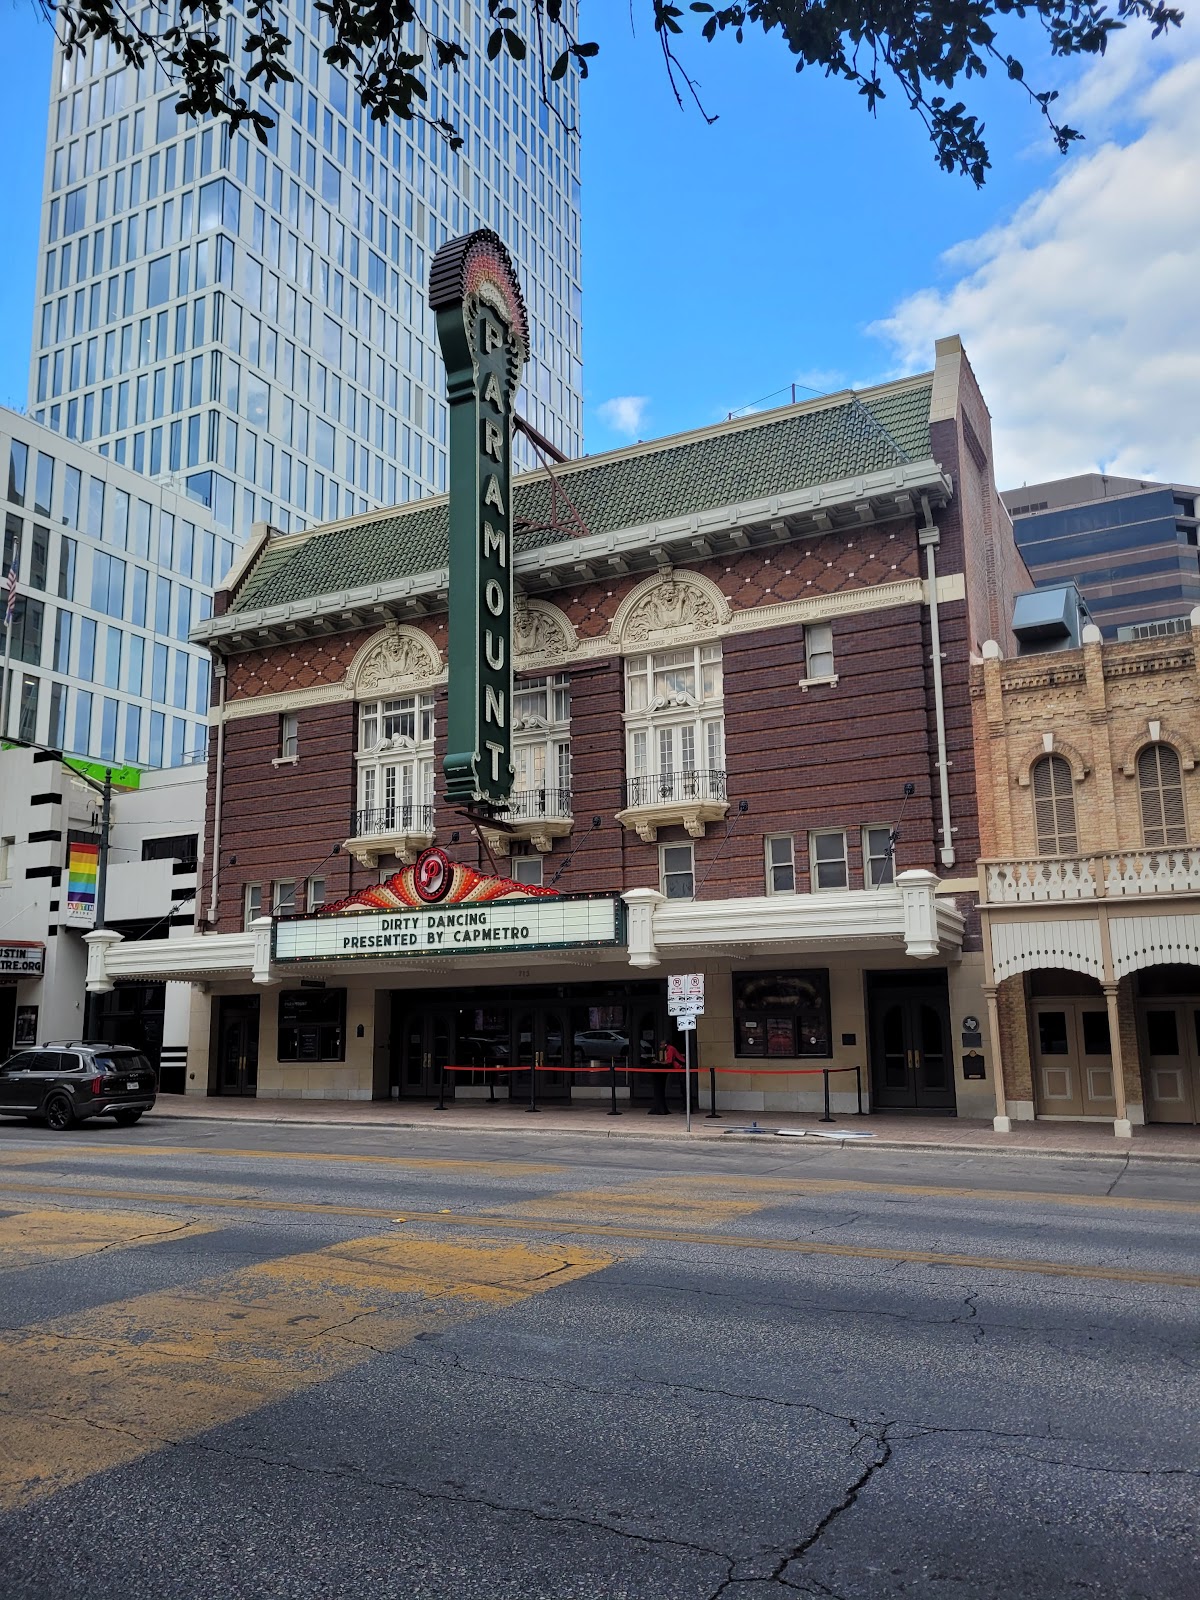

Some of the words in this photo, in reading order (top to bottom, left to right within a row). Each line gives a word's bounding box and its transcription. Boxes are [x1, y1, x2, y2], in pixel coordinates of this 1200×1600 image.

[481, 318, 505, 781] PARAMOUNT
[662, 628, 678, 636] 1915
[382, 917, 419, 931] DIRTY
[427, 912, 487, 928] DANCING
[343, 933, 417, 949] PRESENTED
[427, 931, 443, 944] BY
[453, 926, 529, 942] CAPMETRO
